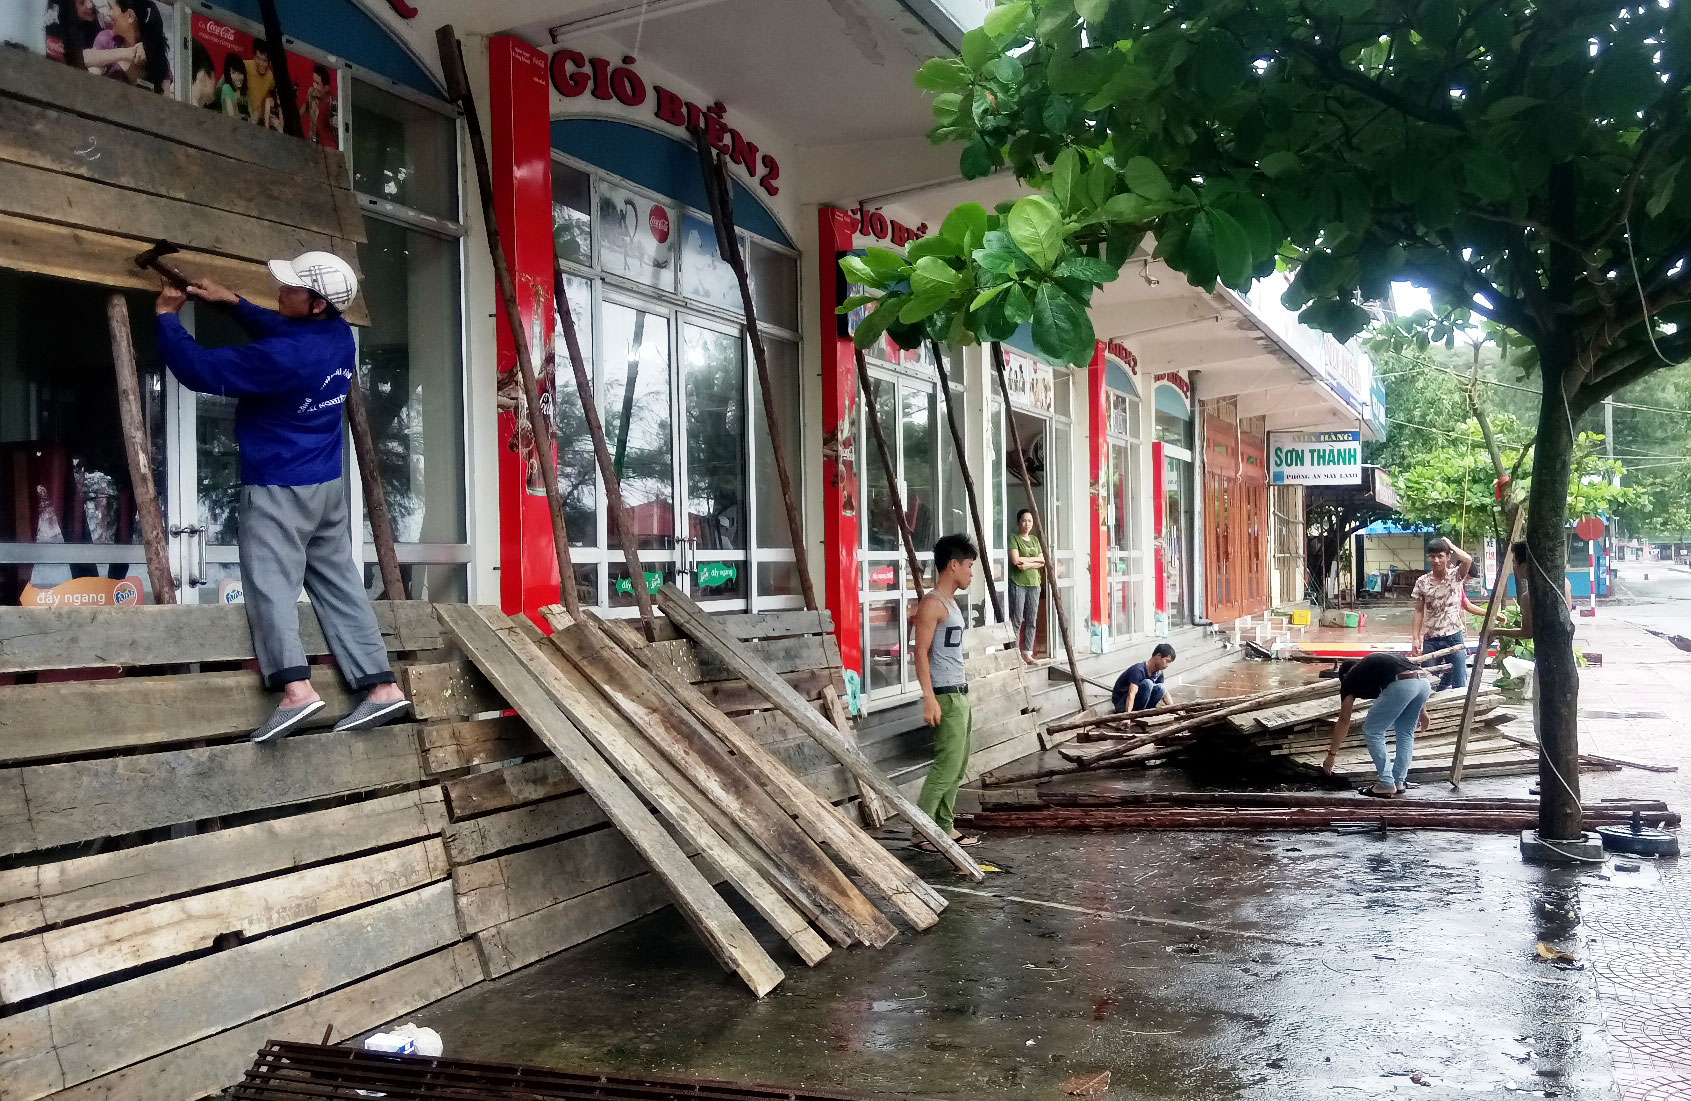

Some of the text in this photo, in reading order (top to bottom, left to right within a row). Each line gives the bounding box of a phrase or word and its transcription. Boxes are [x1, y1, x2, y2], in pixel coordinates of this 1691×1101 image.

[550, 49, 647, 107] GIÓ
[760, 154, 780, 197] 2
[1320, 432, 1353, 442] HÀNG
[1274, 444, 1357, 468] SƠN THÀNH
[36, 590, 61, 607] đẩy
[64, 593, 106, 606] ngang
